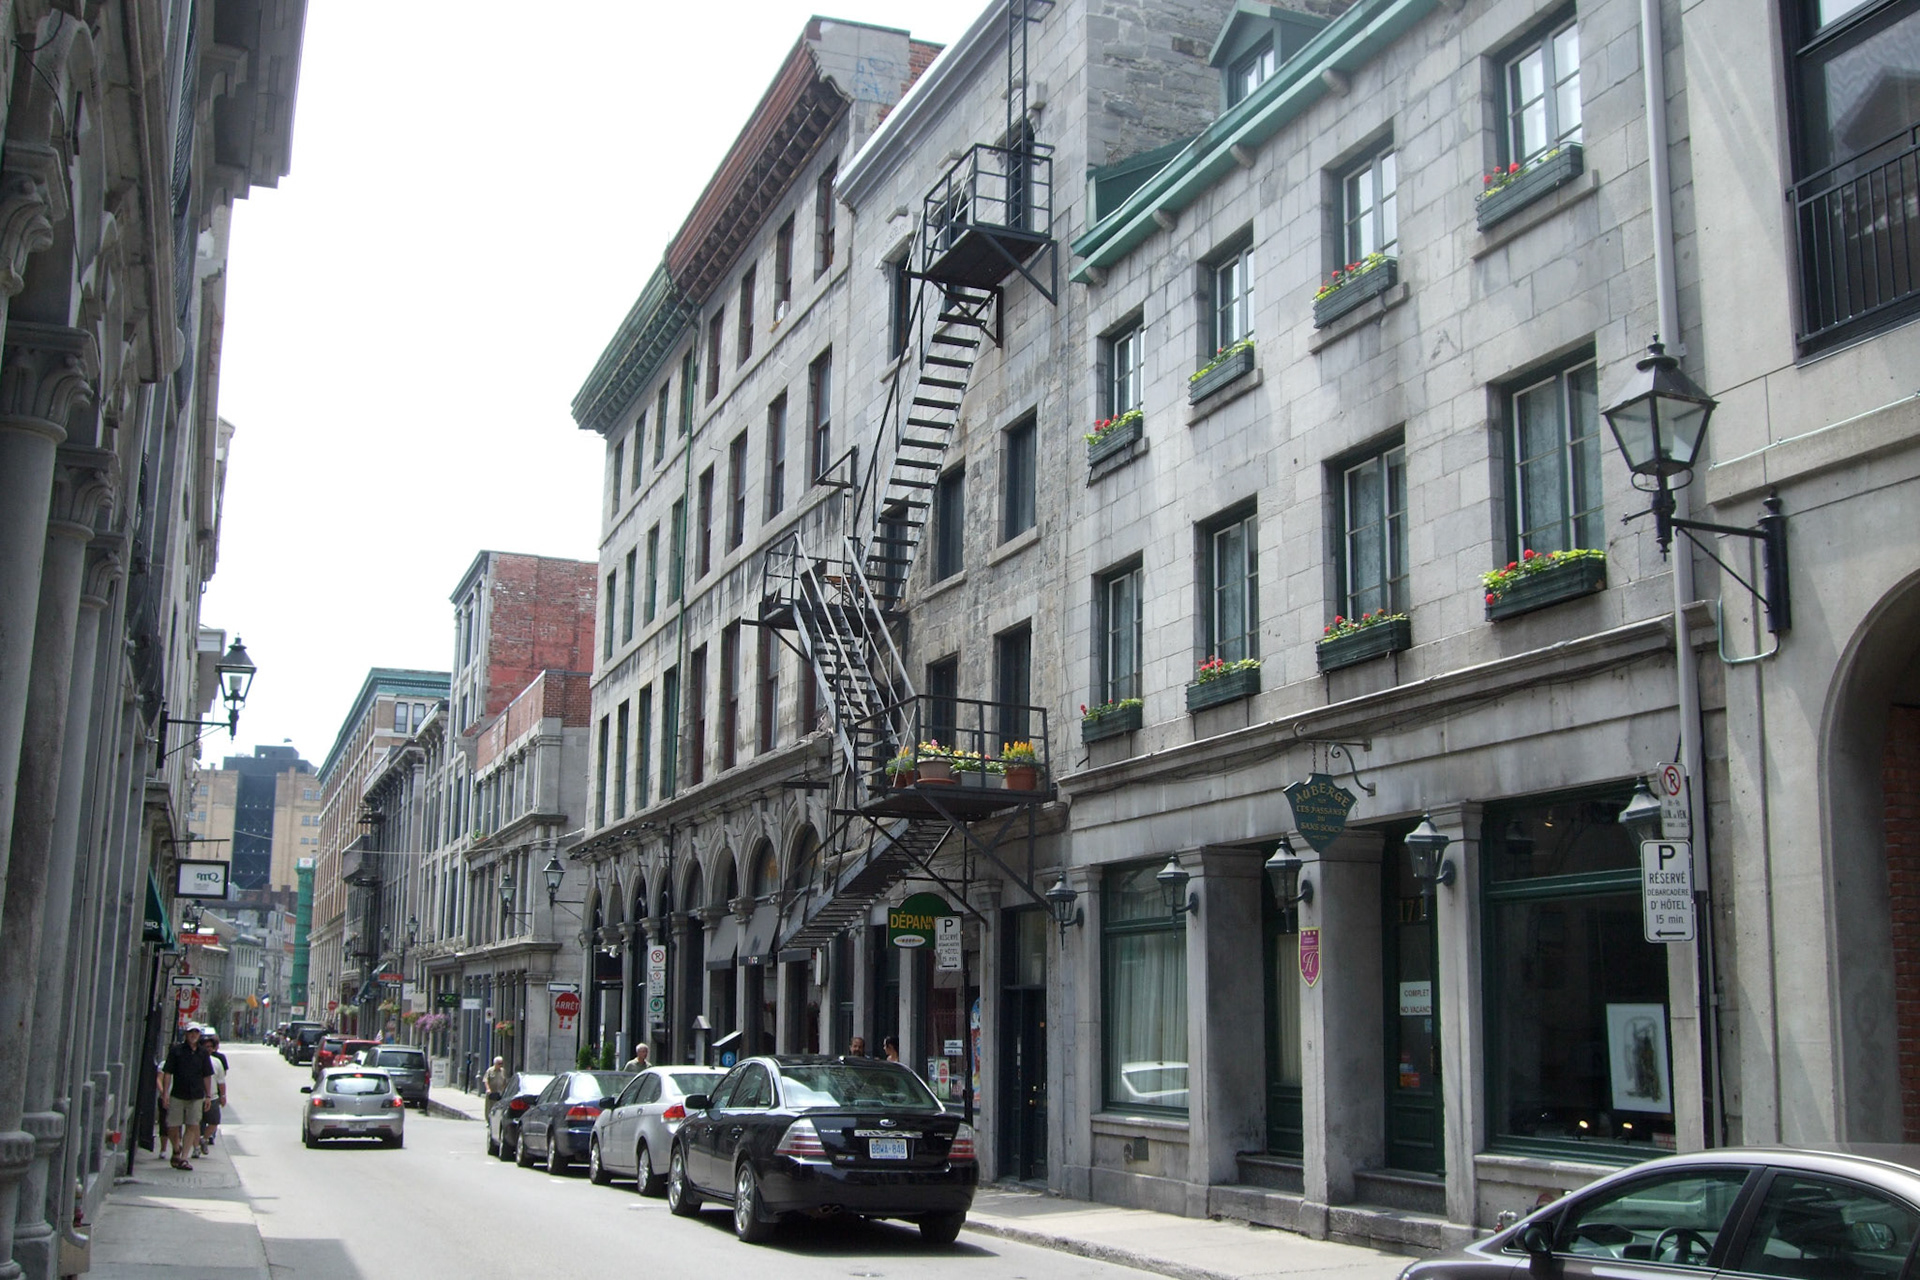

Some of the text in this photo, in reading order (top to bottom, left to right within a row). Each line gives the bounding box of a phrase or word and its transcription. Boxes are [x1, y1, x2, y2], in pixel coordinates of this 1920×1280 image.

[1295, 782, 1349, 808] AUBERGE
[1658, 844, 1676, 871] P
[1649, 871, 1686, 884] RÉSERVÉ
[1647, 888, 1689, 896] DÉBARCADÈRE
[1656, 914, 1664, 925] 15
[944, 919, 954, 933] P
[1404, 988, 1429, 997] COMPLET
[556, 1001, 579, 1010] ARRÊT
[1401, 1005, 1409, 1013] NO
